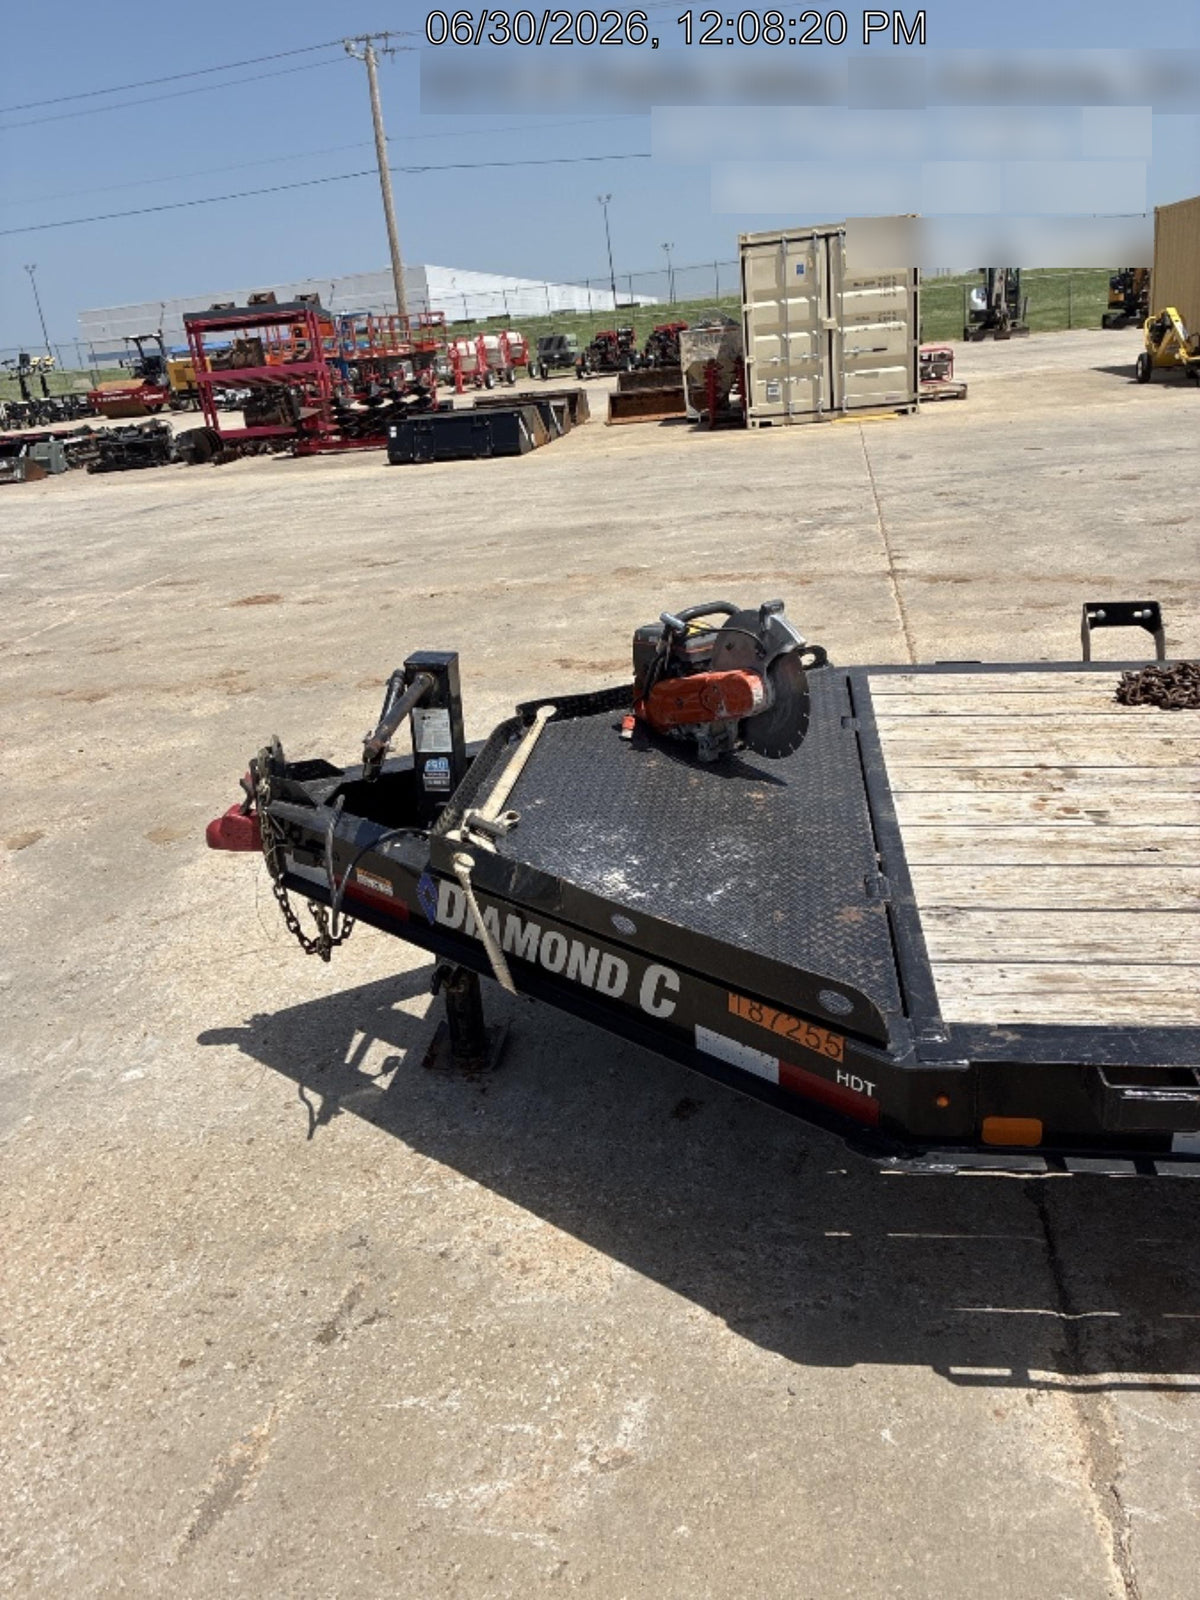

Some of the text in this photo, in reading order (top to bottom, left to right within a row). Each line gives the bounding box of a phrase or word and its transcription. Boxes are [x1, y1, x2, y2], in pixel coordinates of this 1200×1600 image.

[435, 880, 680, 1018] DIAMOND C
[836, 1068, 876, 1097] HDT
